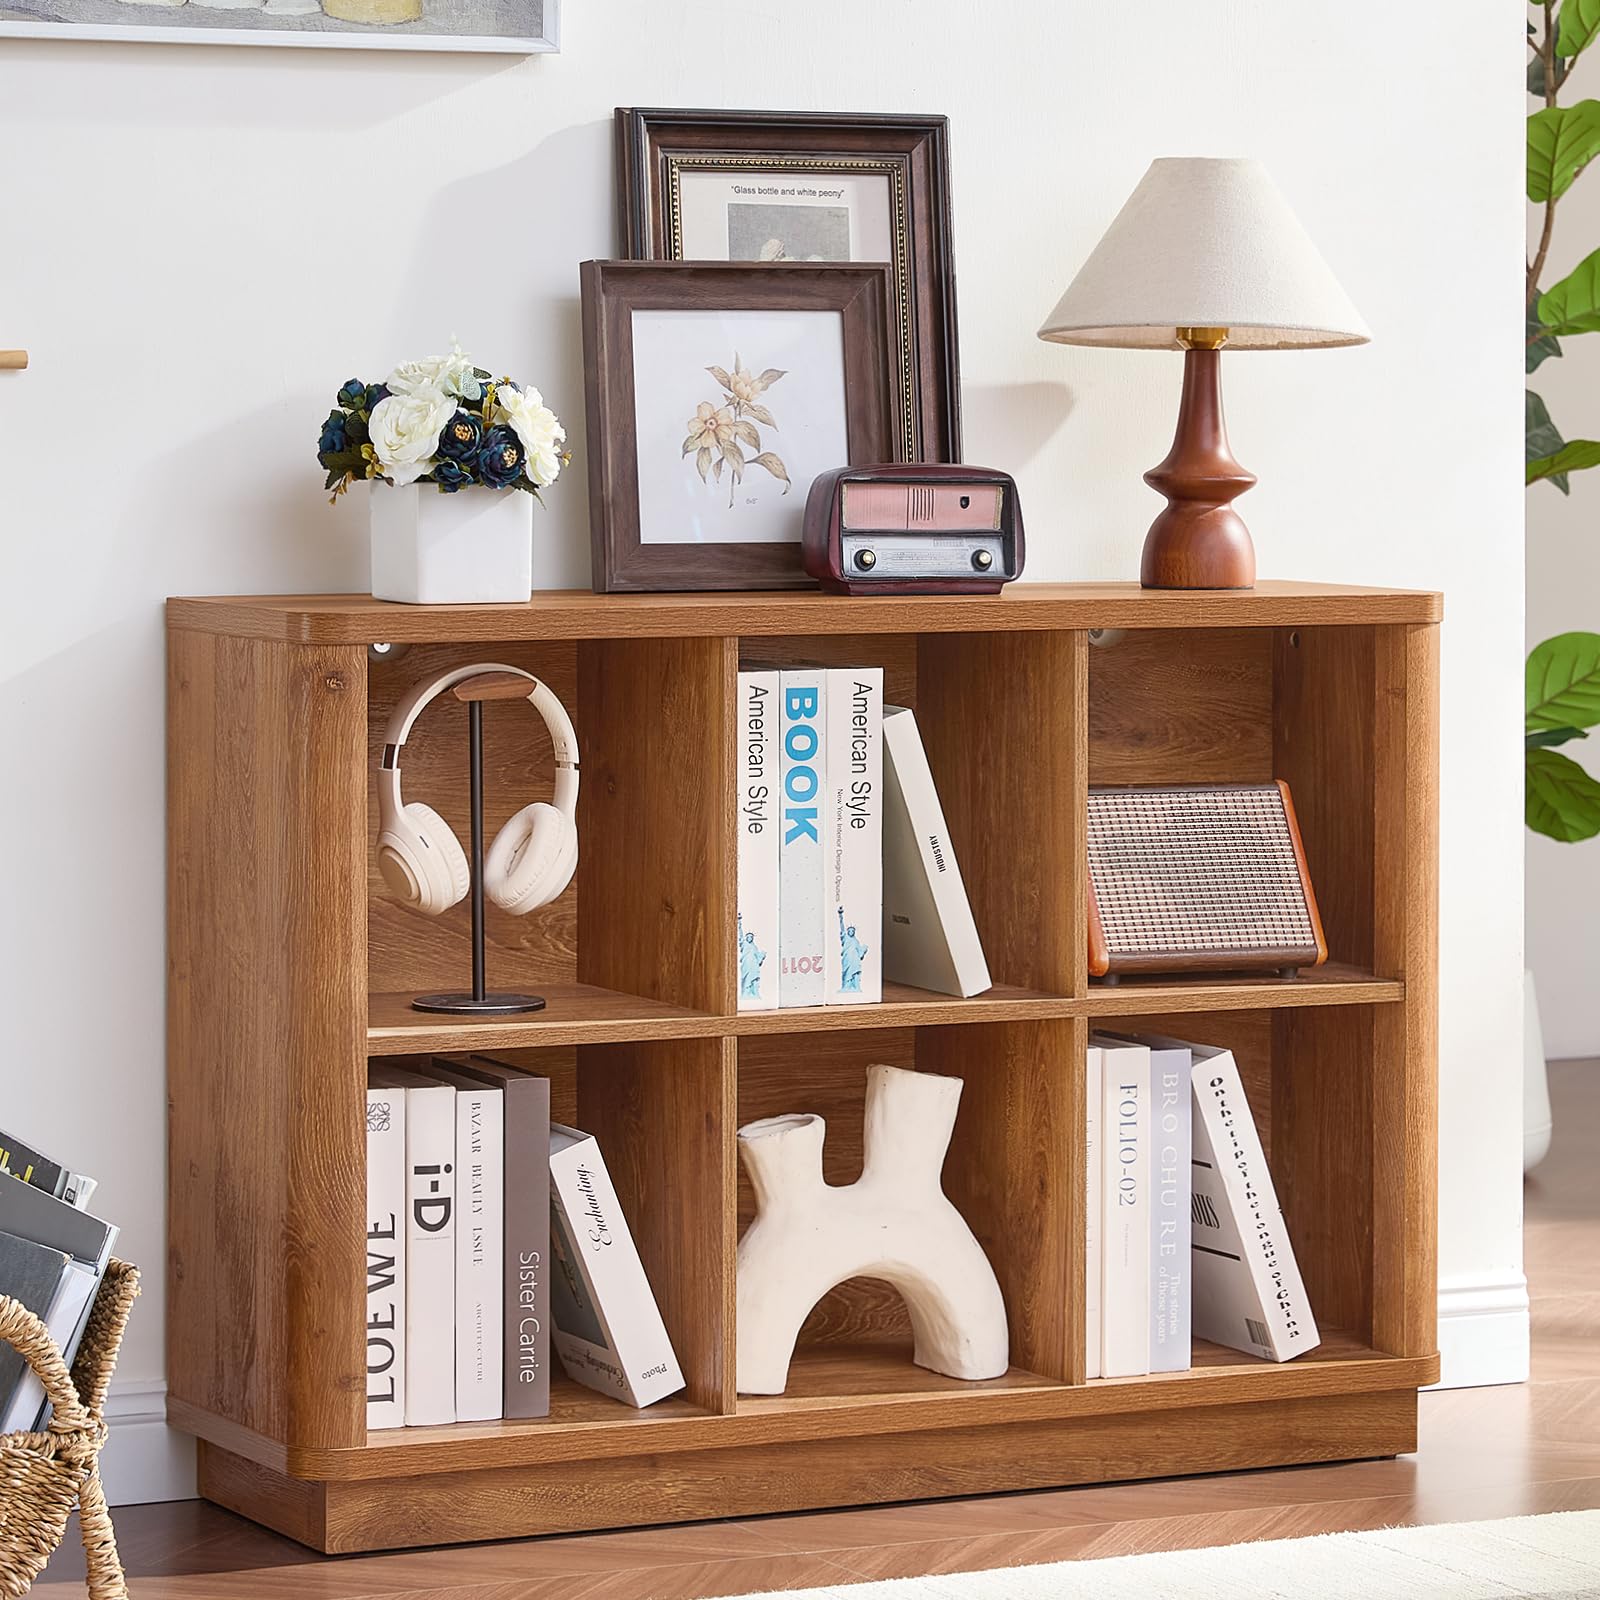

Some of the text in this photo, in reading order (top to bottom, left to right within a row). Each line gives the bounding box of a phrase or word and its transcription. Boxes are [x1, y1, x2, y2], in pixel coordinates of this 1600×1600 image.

[731, 185, 845, 199] "Glass bottle and white peony"
[743, 684, 769, 834] American Style
[785, 687, 819, 846] BOOK
[845, 681, 873, 829] American Style
[929, 834, 947, 873] INDUSTRY
[782, 956, 823, 974] 2011
[471, 1102, 484, 1266] BAZAAR BEAUTY ISSUE
[1119, 1084, 1138, 1206] FOLIO-02
[367, 1212, 396, 1403] LOEWE
[519, 1251, 540, 1384] Sister Carrie
[1154, 1266, 1169, 1345] of those years
[1170, 1271, 1181, 1335] The stories
[641, 1362, 668, 1380] Photo
